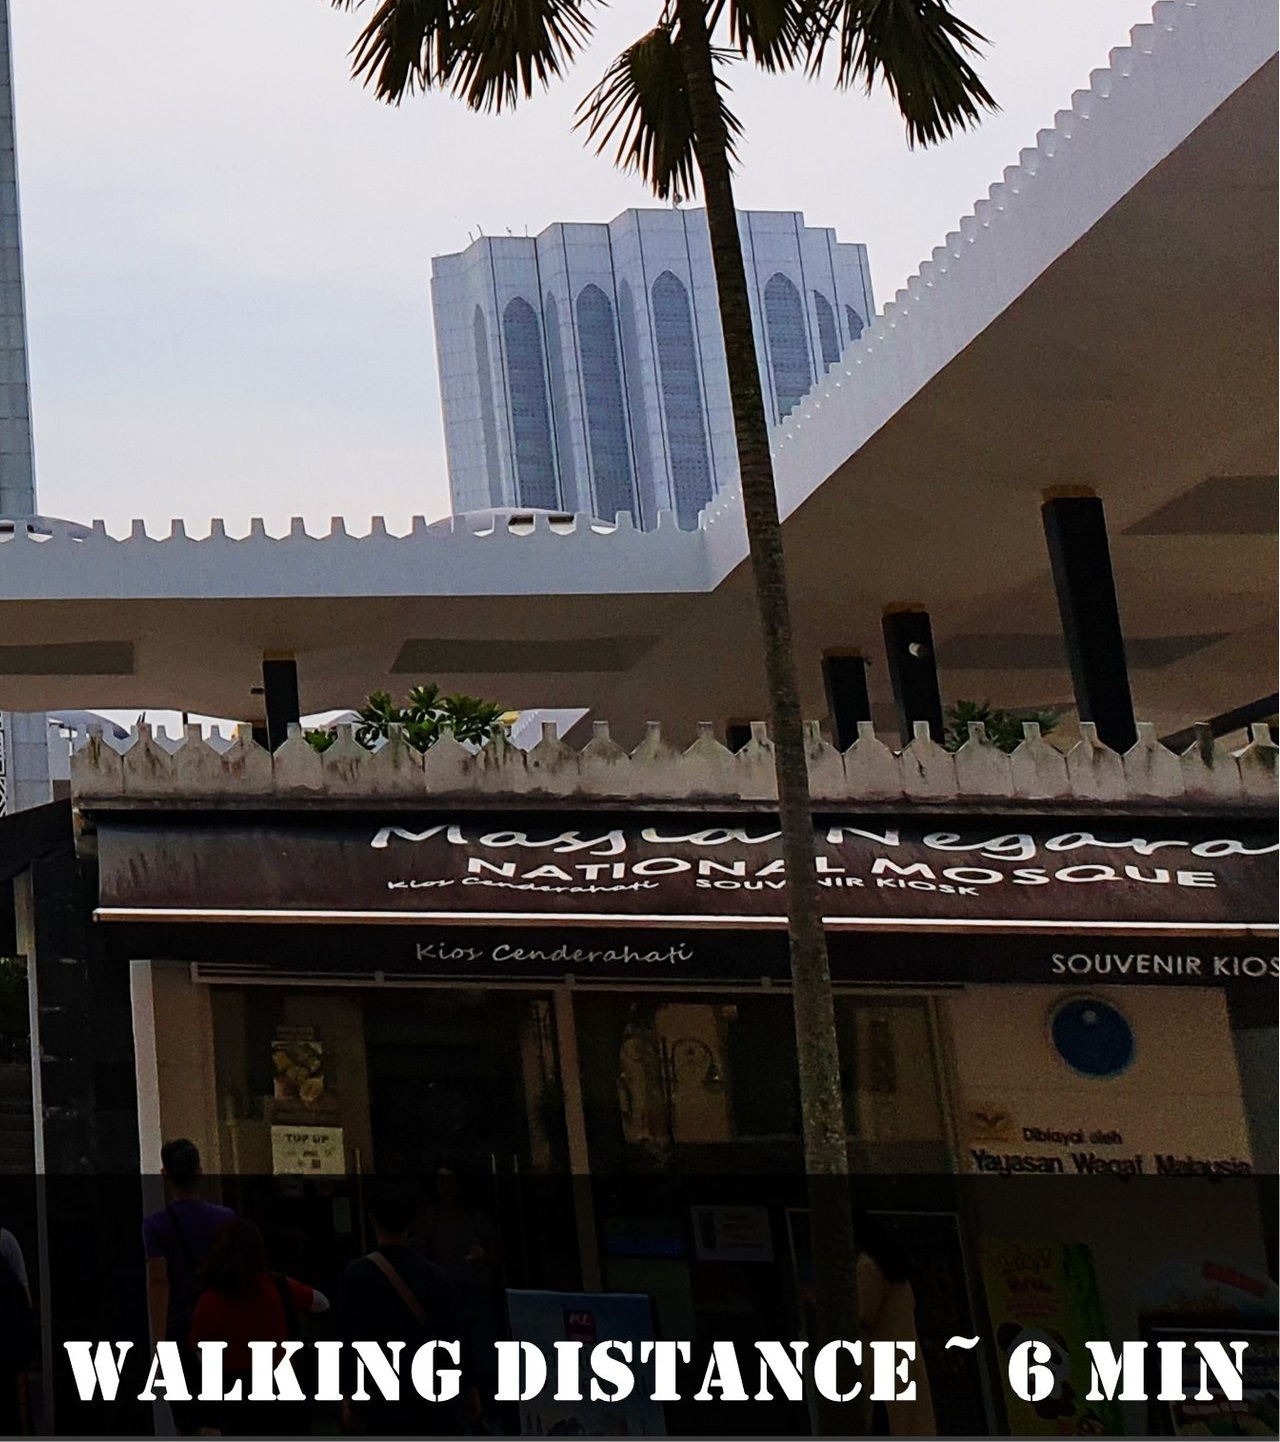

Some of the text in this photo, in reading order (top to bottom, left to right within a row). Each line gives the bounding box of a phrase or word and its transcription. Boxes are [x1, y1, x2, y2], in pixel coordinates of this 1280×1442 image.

[870, 858, 1218, 888] MOSQUE
[695, 877, 865, 891] SOUVNIR
[876, 877, 980, 896] KIOSK
[415, 942, 694, 965] Kios Cenderahati
[1050, 953, 1203, 976] SOUVENIR
[971, 1149, 1064, 1179] Yayasan
[1154, 1154, 1252, 1184] Malaysia
